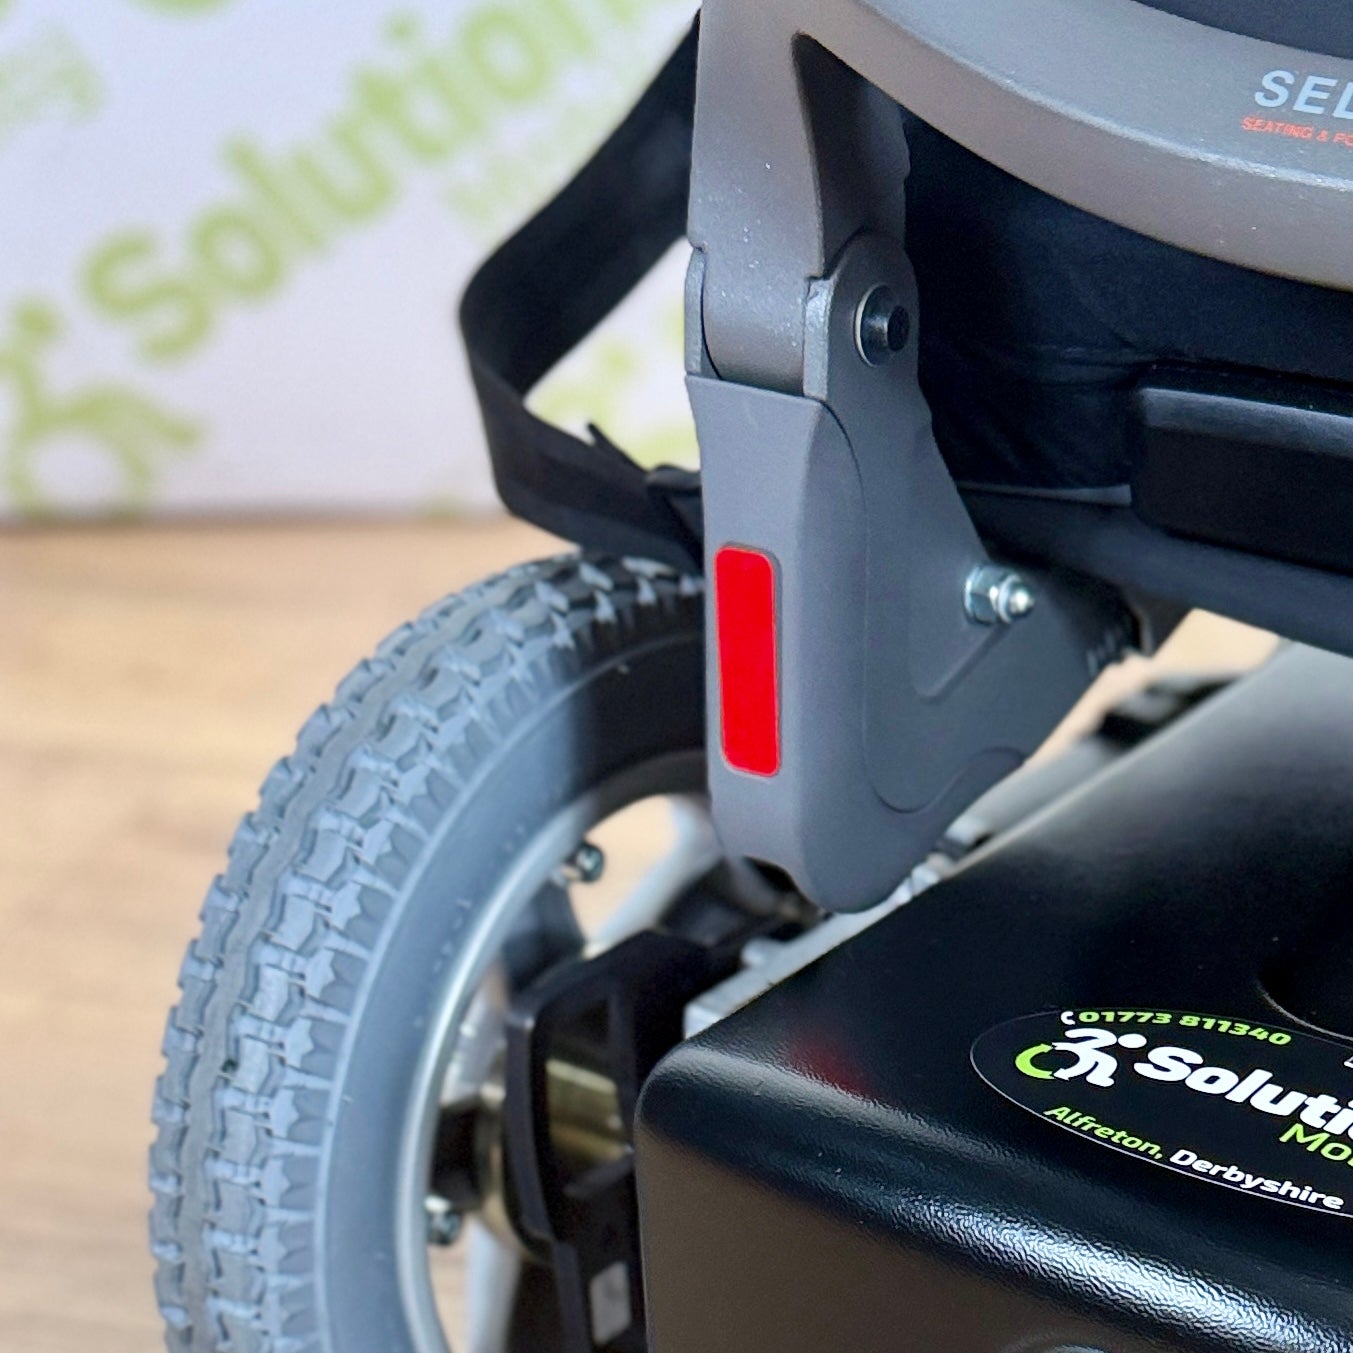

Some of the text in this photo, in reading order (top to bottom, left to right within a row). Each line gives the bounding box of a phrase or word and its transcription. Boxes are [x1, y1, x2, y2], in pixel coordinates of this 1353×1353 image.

[1241, 115, 1314, 141] SEATING
[1316, 129, 1329, 143] &
[1078, 1011, 1292, 1045] 01773 811340
[1043, 1106, 1345, 1210] Alfreton, Derbyshire
